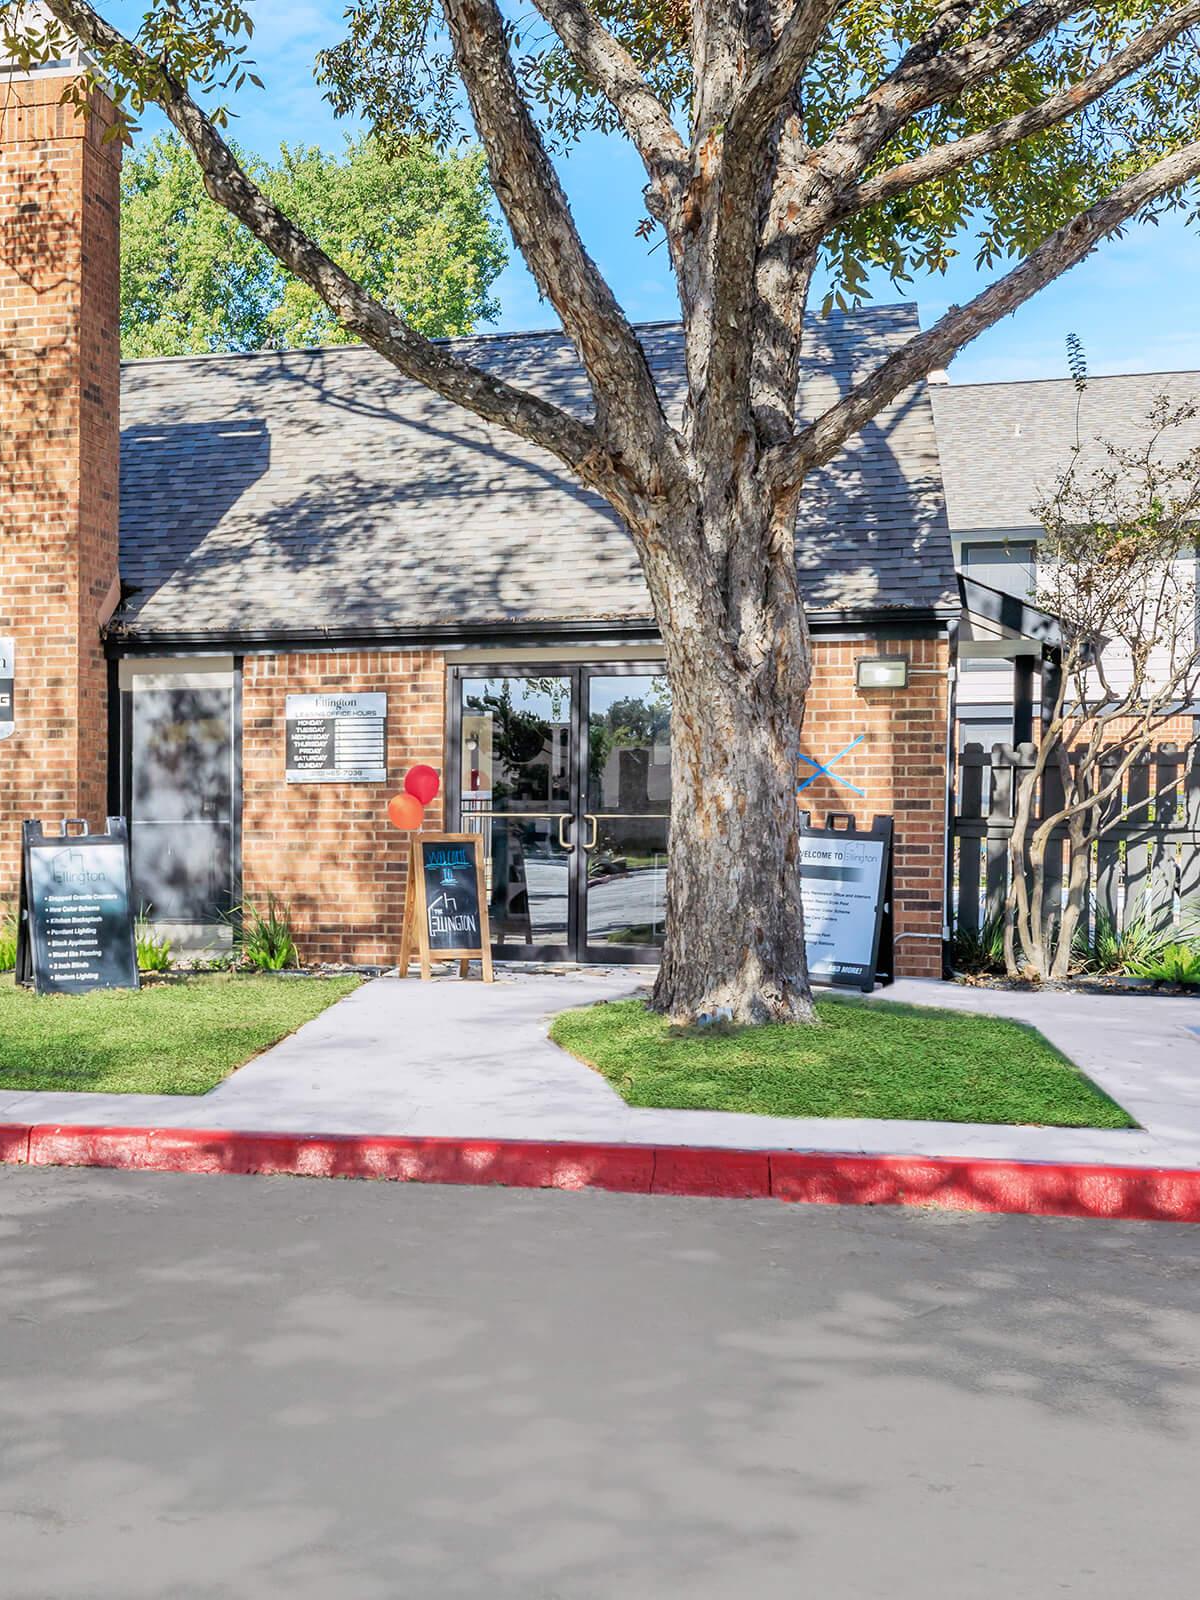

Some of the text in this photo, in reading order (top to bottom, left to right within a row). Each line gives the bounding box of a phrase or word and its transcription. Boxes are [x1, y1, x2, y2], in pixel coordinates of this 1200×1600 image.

[834, 851, 844, 861] TO
[56, 871, 105, 885] Ellington
[431, 914, 477, 932] ELLINGTON
[841, 966, 863, 975] MORE!
